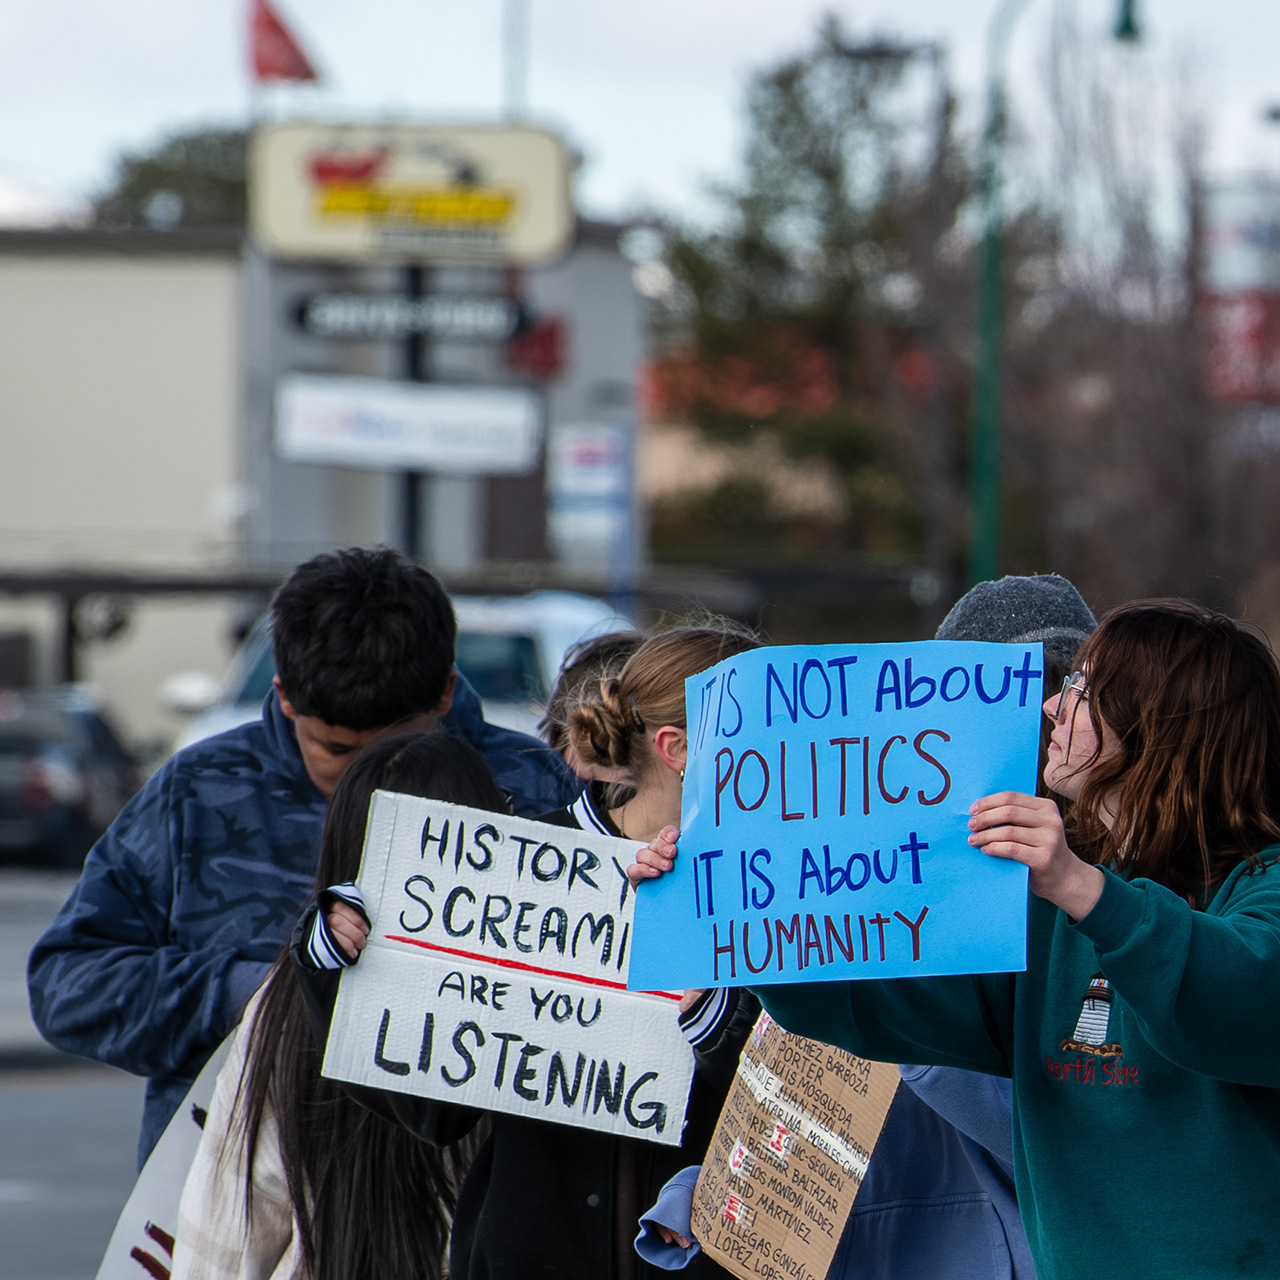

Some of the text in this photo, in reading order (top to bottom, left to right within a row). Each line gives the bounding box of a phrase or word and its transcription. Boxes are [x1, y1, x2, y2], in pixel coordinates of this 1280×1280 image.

[694, 677, 716, 756] IT
[715, 668, 743, 738] IS
[766, 656, 858, 728] NOT
[714, 729, 952, 827] POLITICS
[693, 849, 724, 919] IT
[740, 848, 775, 911] IS
[437, 970, 603, 1028] ARE YOU
[374, 1008, 668, 1135] LISTENING
[779, 1040, 825, 1087] PORTER
[1045, 1055, 1140, 1086] North Shore
[799, 1077, 853, 1130] MOSQUEDA
[791, 1169, 839, 1214] BALTAZAR
[755, 1193, 813, 1245] MARTINEZ
[804, 1200, 834, 1239] VALDEZ
[714, 1230, 753, 1271] LOPEZ
